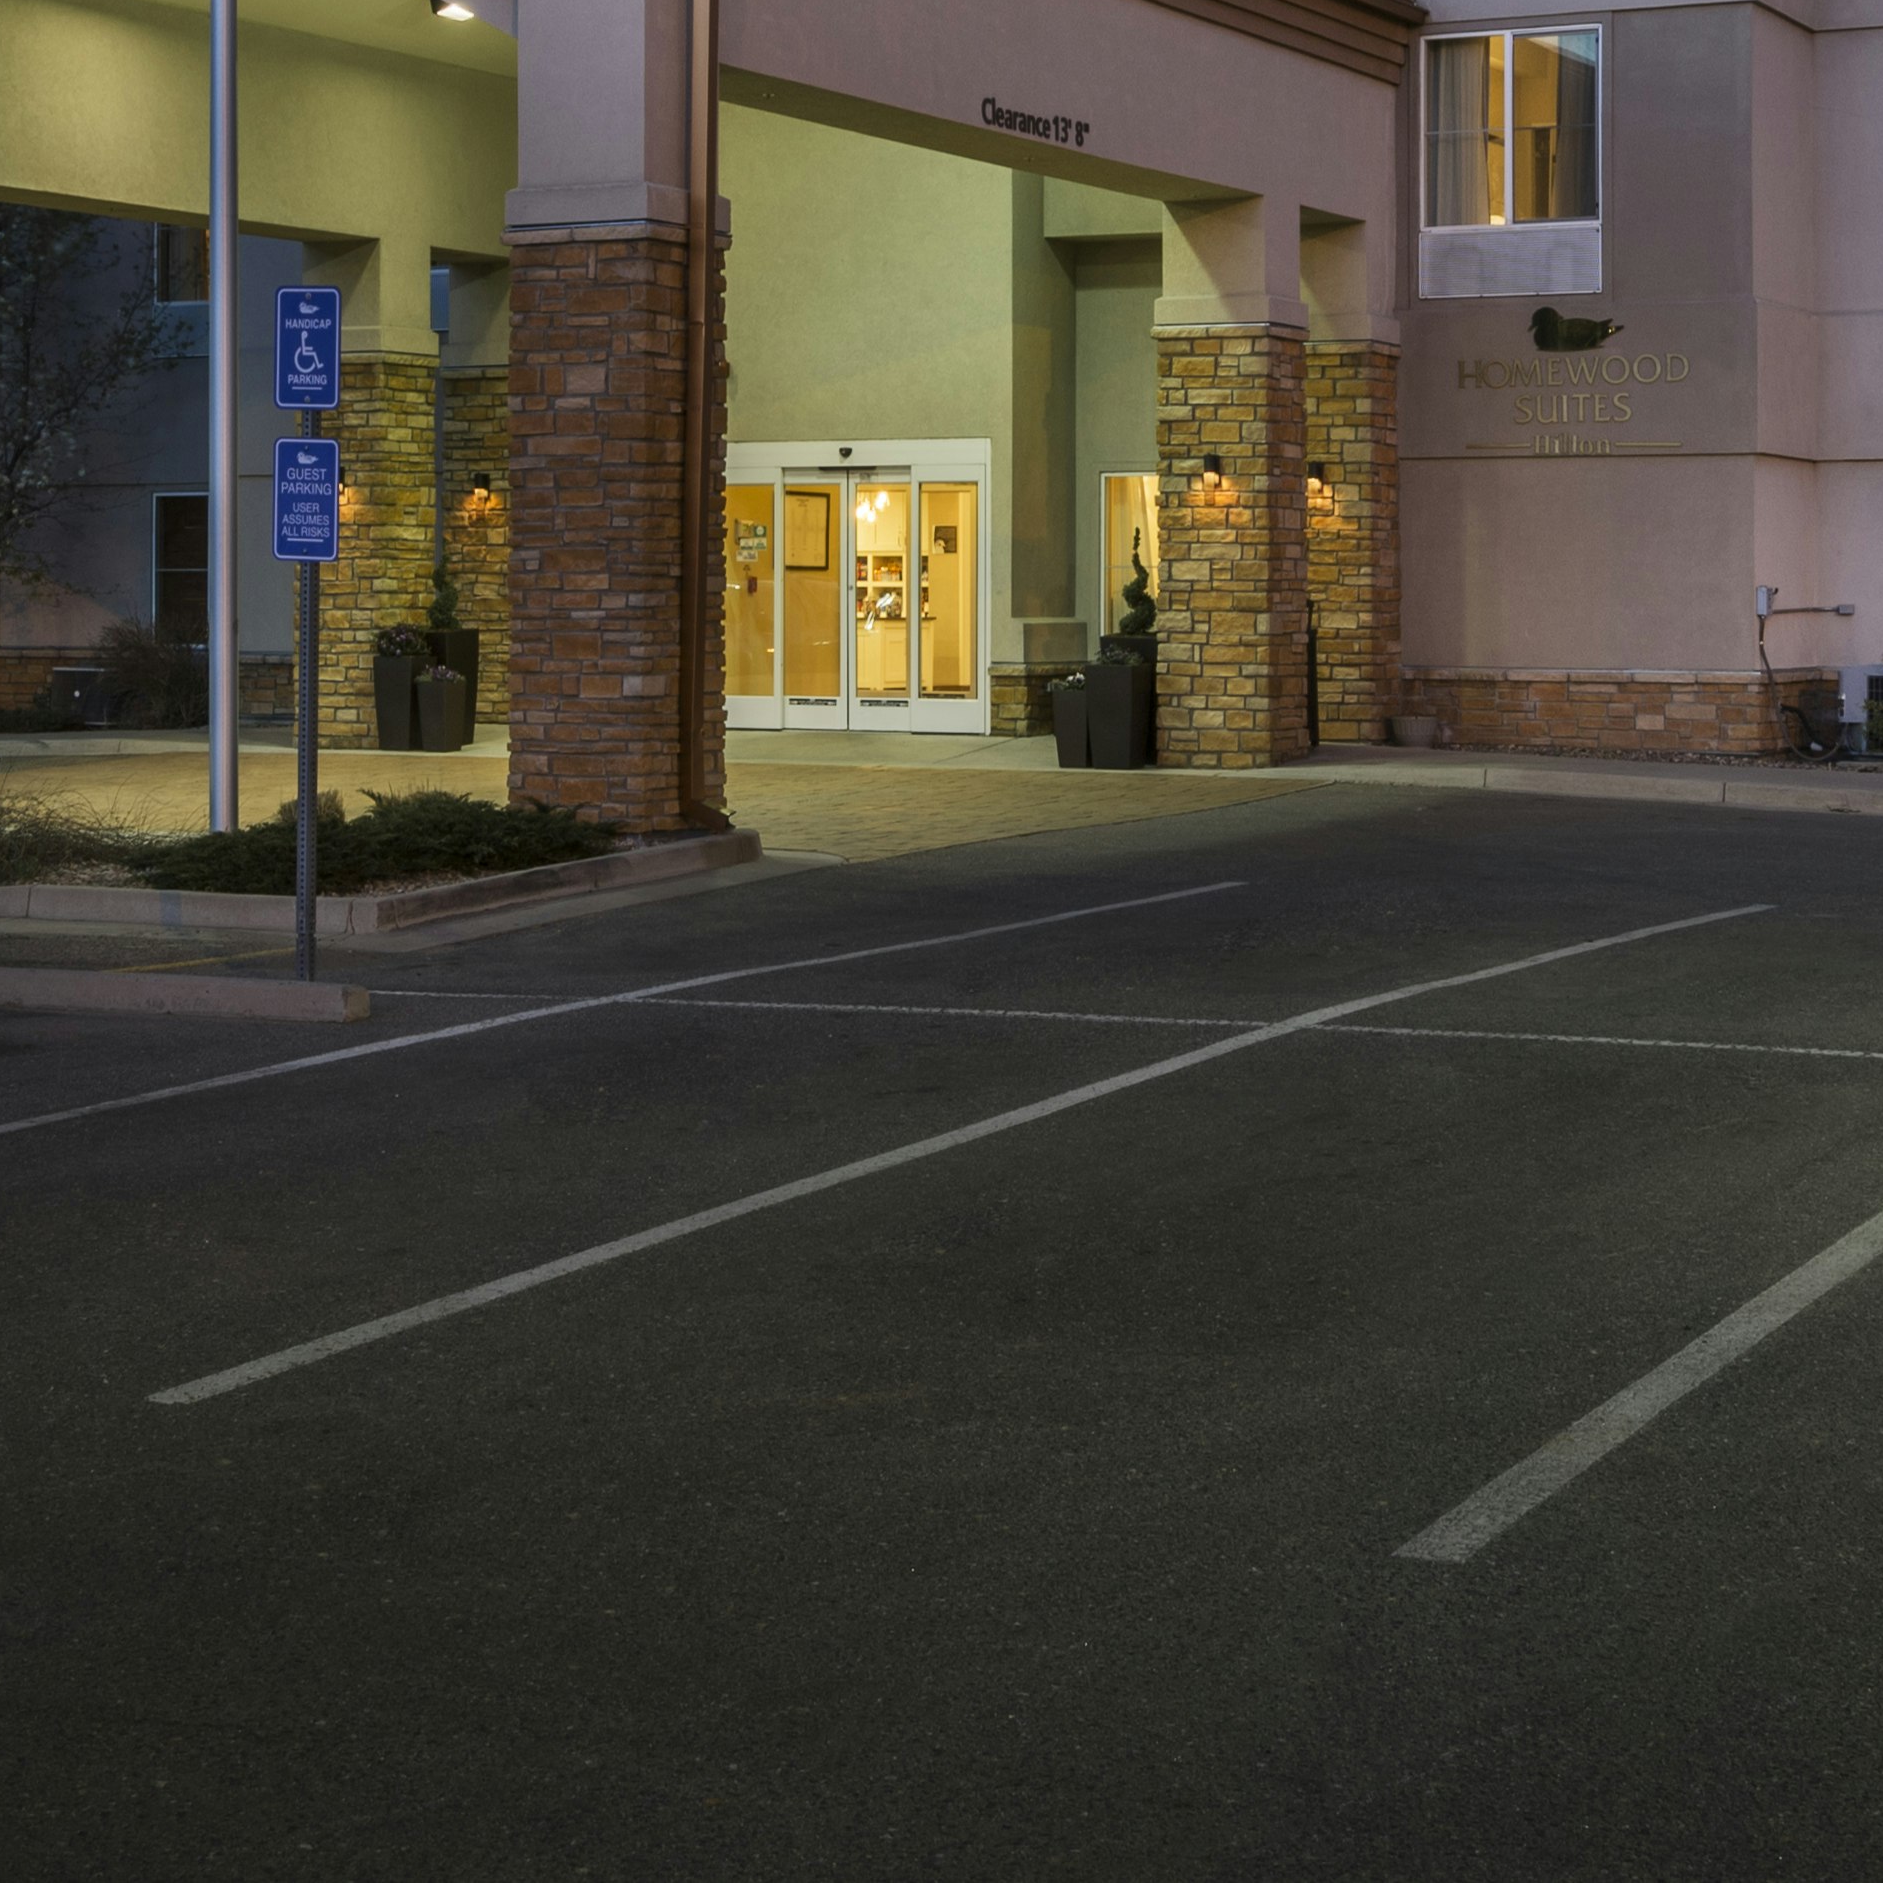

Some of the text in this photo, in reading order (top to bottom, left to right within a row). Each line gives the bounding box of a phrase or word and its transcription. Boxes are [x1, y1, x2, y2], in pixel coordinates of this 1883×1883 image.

[981, 97, 1090, 147] Clearance 13' 8"
[285, 318, 332, 329] HANDICAP
[1457, 353, 1690, 389] HOMEWOOD
[288, 374, 327, 385] PARKING
[1514, 392, 1633, 424] SUITES
[286, 467, 327, 481] GUEST
[281, 482, 332, 495] PARKING
[292, 502, 320, 513] USER
[281, 514, 330, 526] ASSUMES
[281, 526, 331, 538] ALL RISKS
